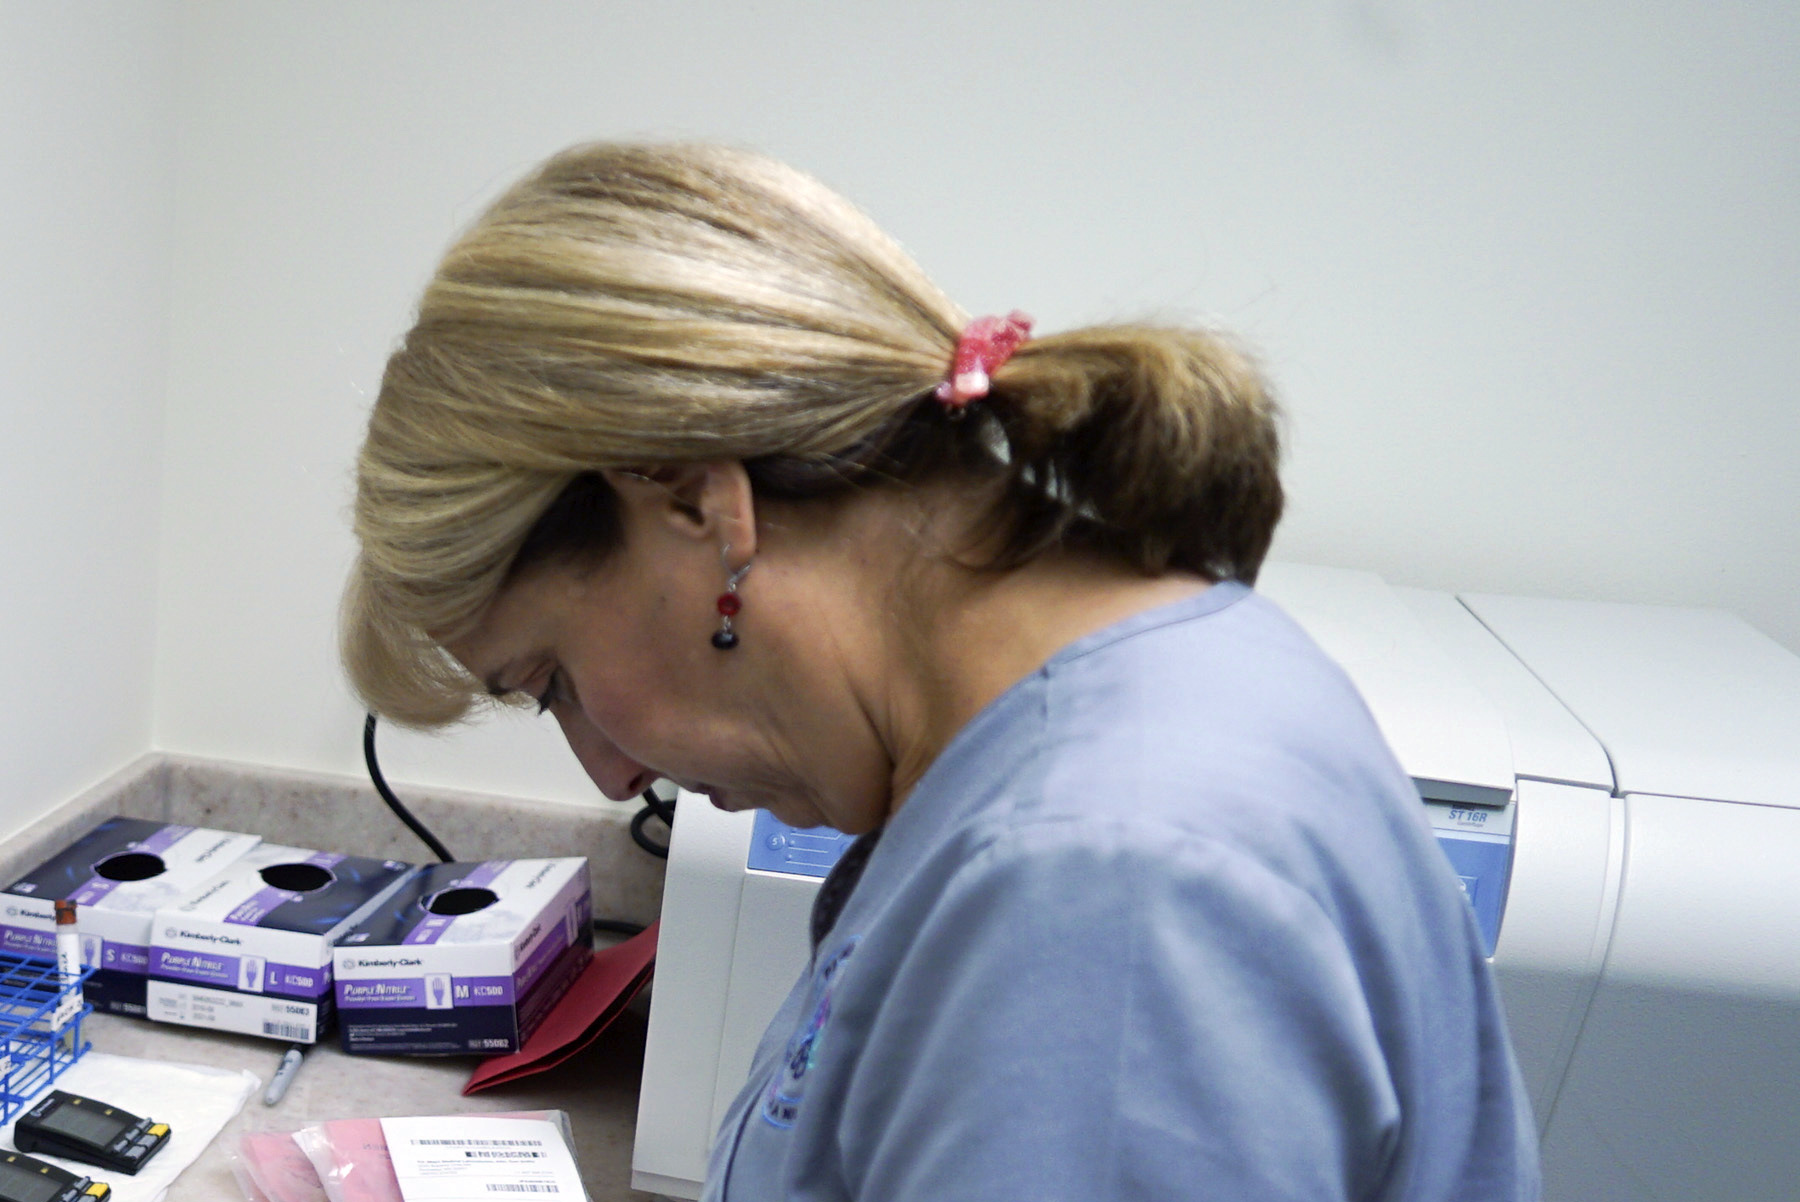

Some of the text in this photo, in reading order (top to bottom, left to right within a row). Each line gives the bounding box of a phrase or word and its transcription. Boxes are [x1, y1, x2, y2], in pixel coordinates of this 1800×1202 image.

[1449, 810, 1488, 822] ST 16R
[180, 930, 241, 945] Kimberly-Clark
[106, 949, 115, 962] S
[358, 958, 422, 968] Kimberly-Clark
[270, 971, 278, 985] L
[285, 975, 314, 988] KC500
[456, 985, 469, 998] M
[474, 986, 503, 996] KC500
[484, 1039, 509, 1048] 55082
